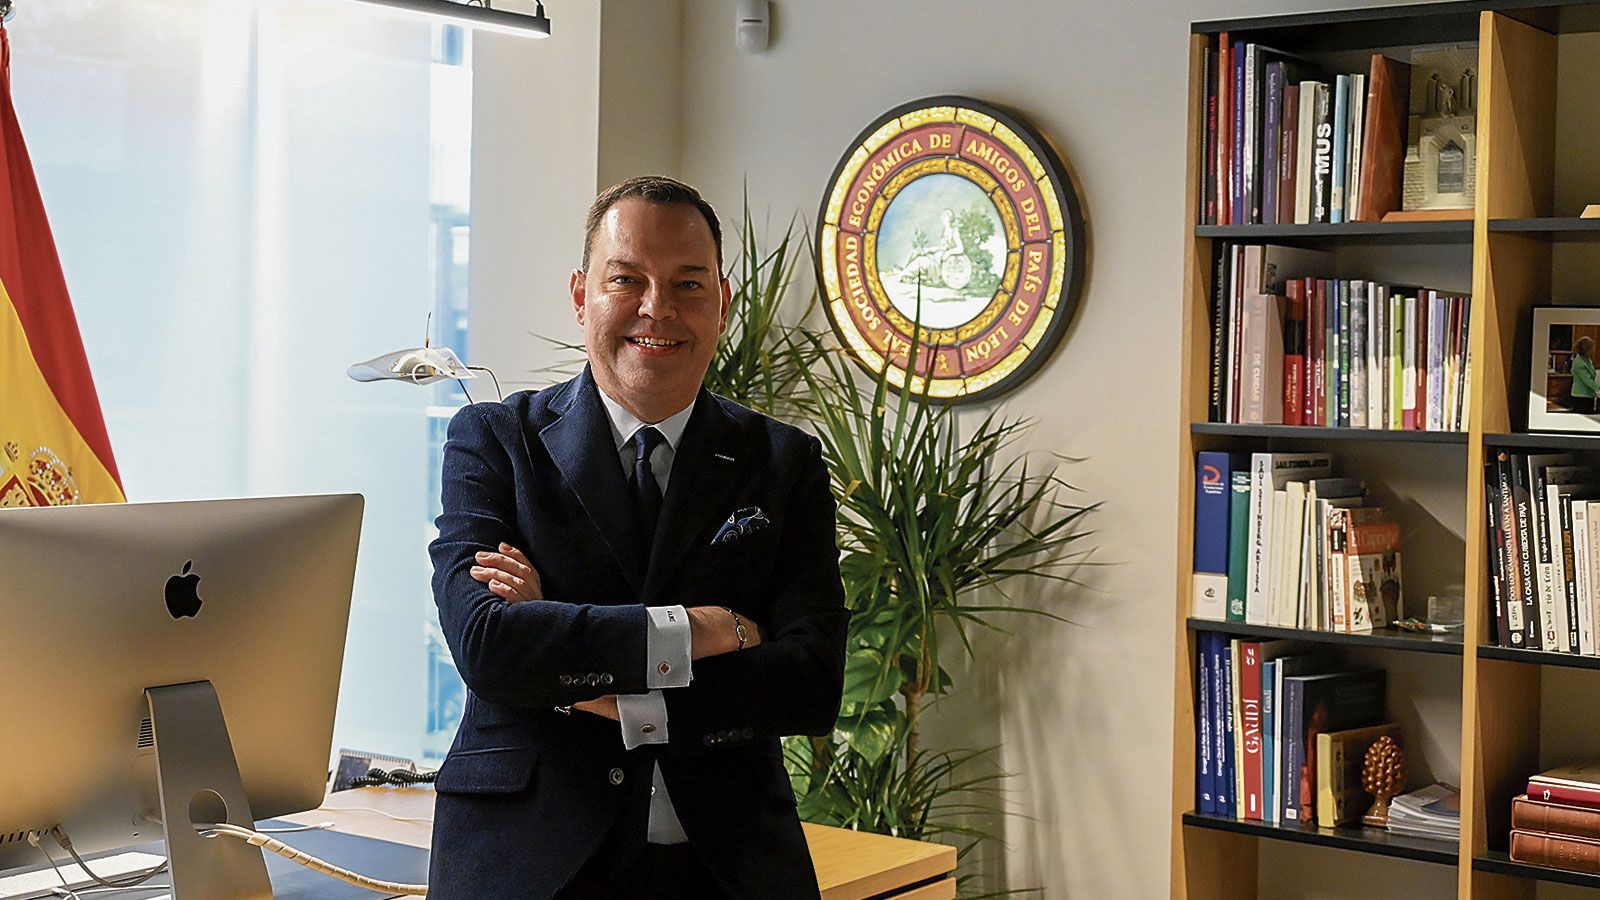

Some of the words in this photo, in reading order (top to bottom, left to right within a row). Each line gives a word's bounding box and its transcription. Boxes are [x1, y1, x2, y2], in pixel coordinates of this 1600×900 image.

[929, 133, 952, 149] DE
[1315, 122, 1332, 175] MUS
[848, 138, 923, 227] ECONÓMICA
[966, 139, 1026, 193] AMIGOS
[1020, 197, 1041, 237] DEL
[845, 236, 881, 331] SOCIEDAD
[1023, 250, 1042, 294] PAÍS
[1008, 298, 1030, 327] DE
[967, 326, 1010, 363] LEÓN
[1253, 352, 1261, 366] DE
[1252, 367, 1261, 402] CUIDAR
[1519, 517, 1527, 528] DE
[1505, 539, 1514, 572] CAMINOS
[1522, 560, 1531, 577] CON
[1524, 576, 1532, 596] CASA
[1525, 595, 1533, 606] LA
[1243, 698, 1259, 754] GAUDÍ
